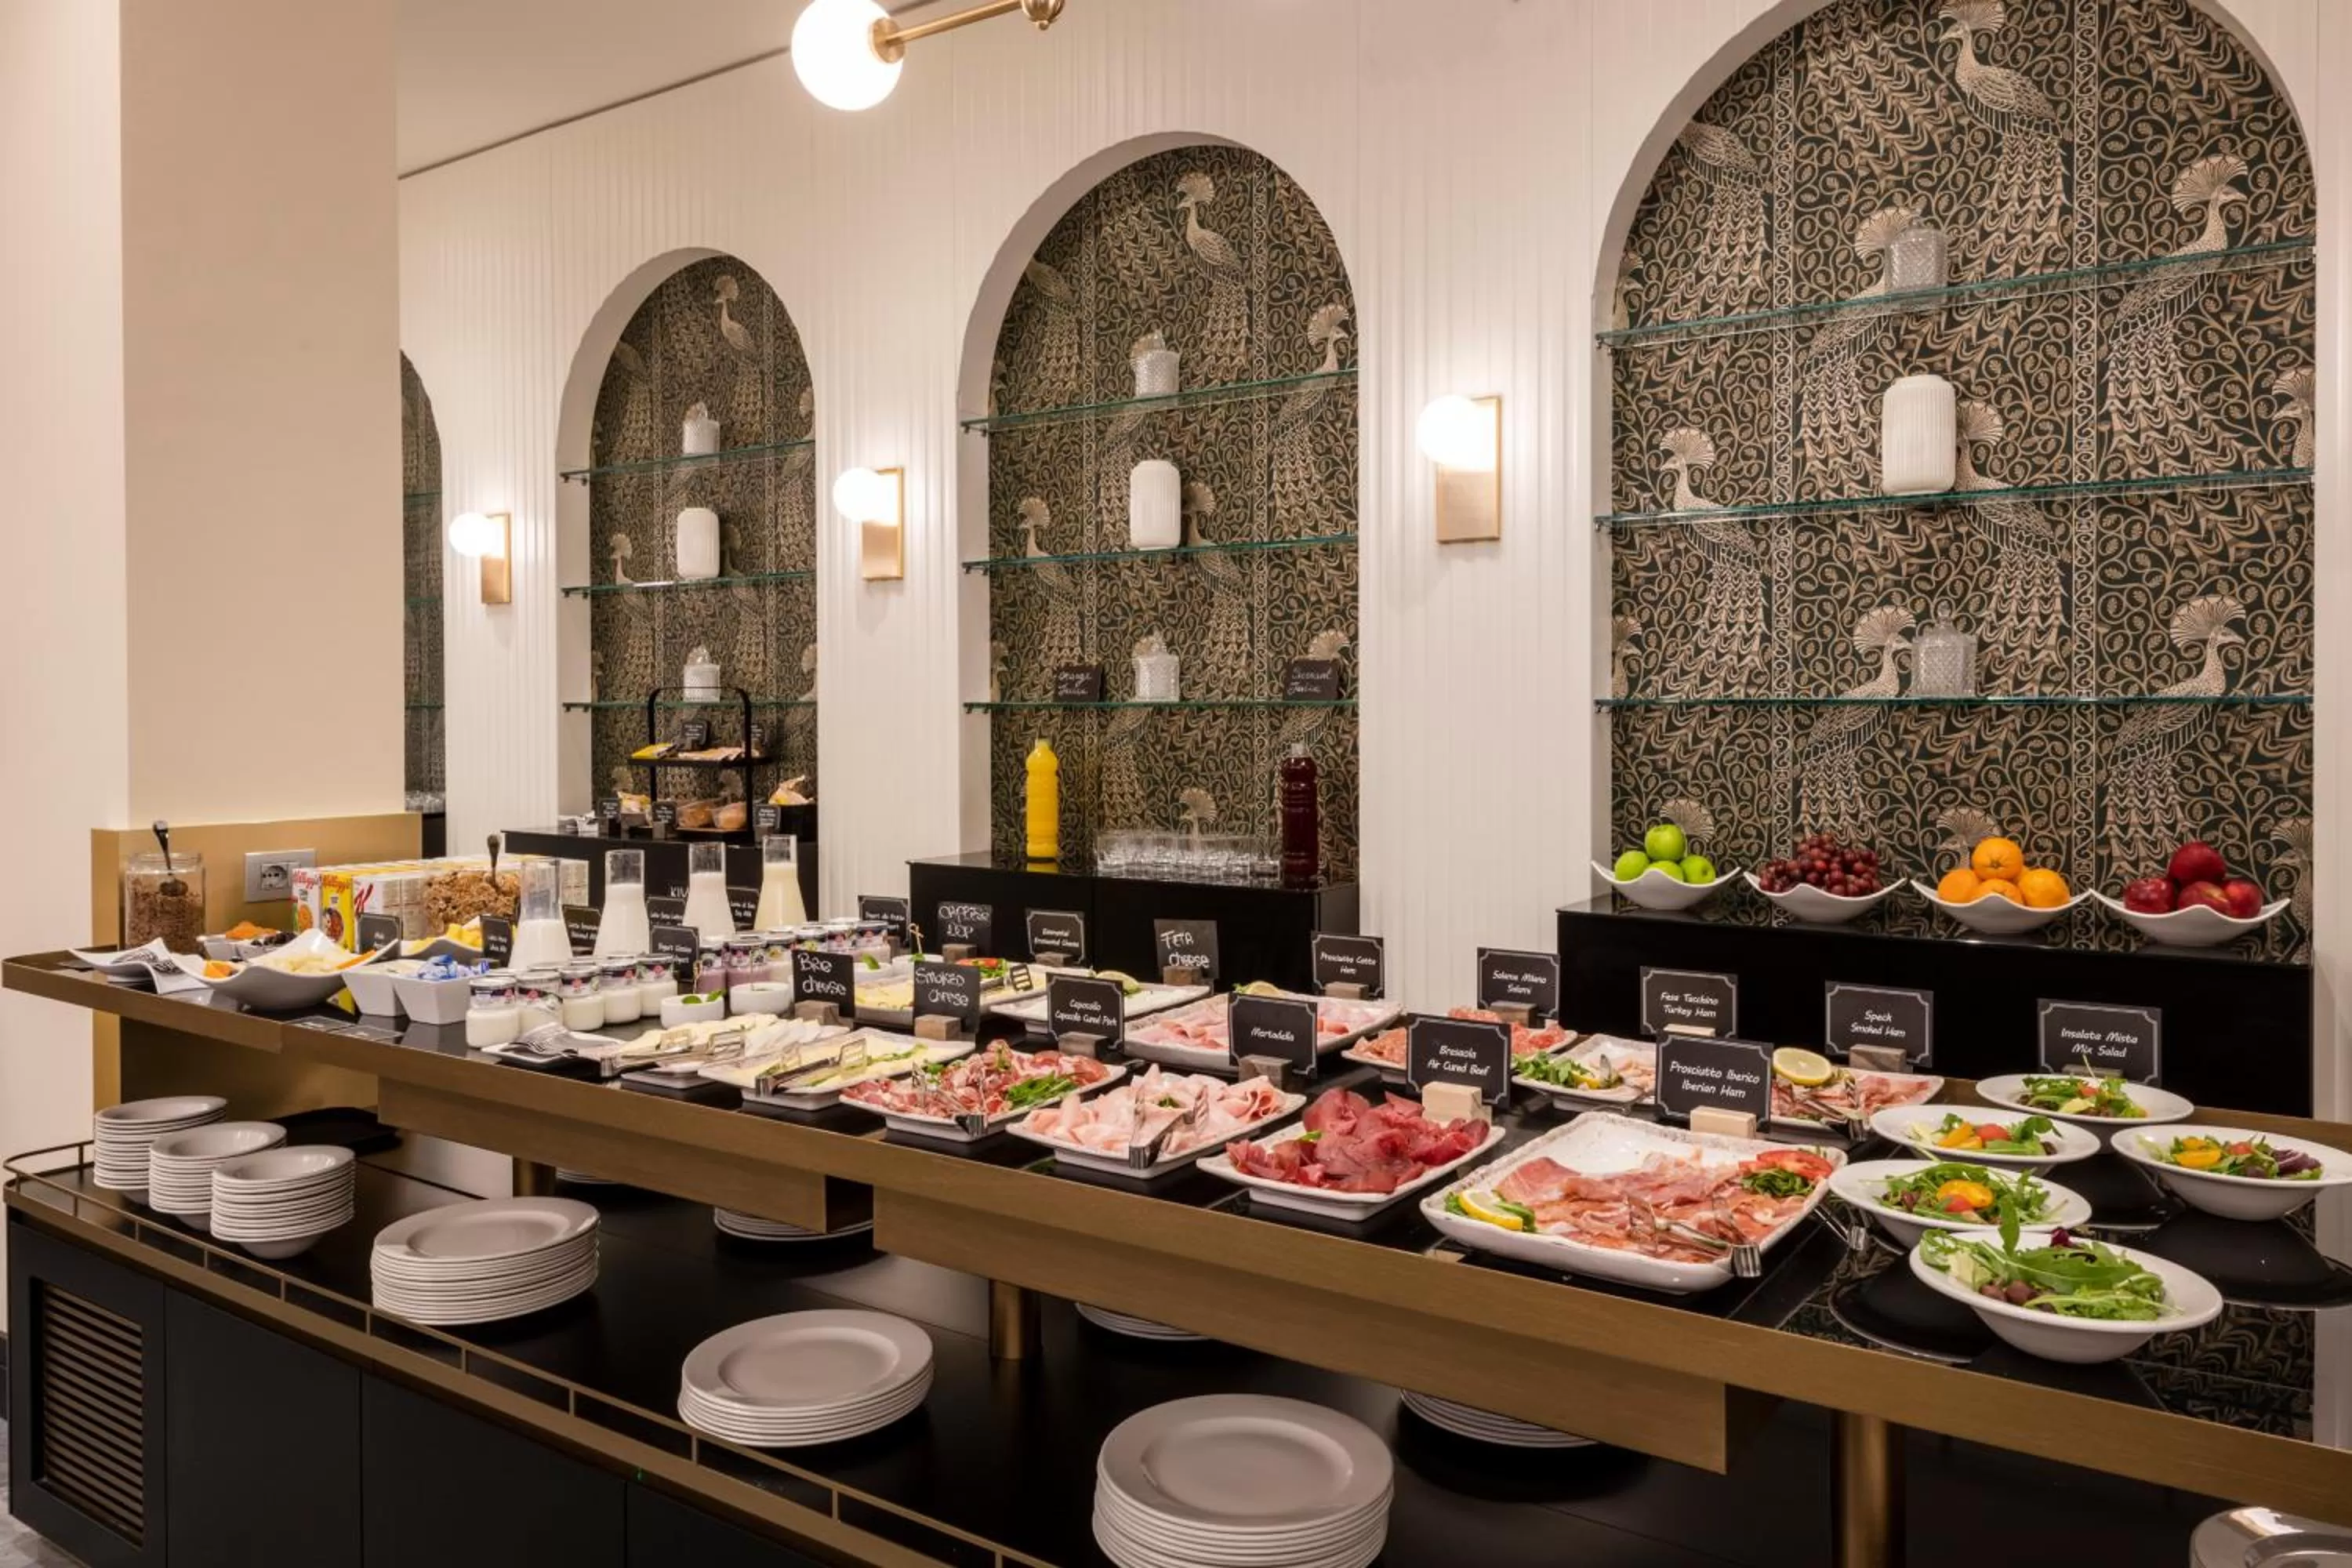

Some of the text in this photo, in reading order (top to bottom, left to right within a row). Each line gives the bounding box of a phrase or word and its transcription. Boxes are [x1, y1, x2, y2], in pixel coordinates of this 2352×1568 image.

[1660, 992, 1719, 1006] Fesa Tacchino
[1663, 1004, 1716, 1018] Turkey Ham
[1864, 1009, 1893, 1022] Speck
[1250, 1026, 1295, 1042] Mortadella
[1850, 1022, 1906, 1037] Smoked Ham
[2060, 1028, 2139, 1044] Insalata Mista
[1439, 1045, 1477, 1059] Bresaola
[2071, 1044, 2127, 1058] Mix Salad
[1428, 1058, 1490, 1076] Air Cured Beef
[1669, 1061, 1761, 1084] Prosciutto Iberico
[1682, 1080, 1746, 1098] Iberian Ham
